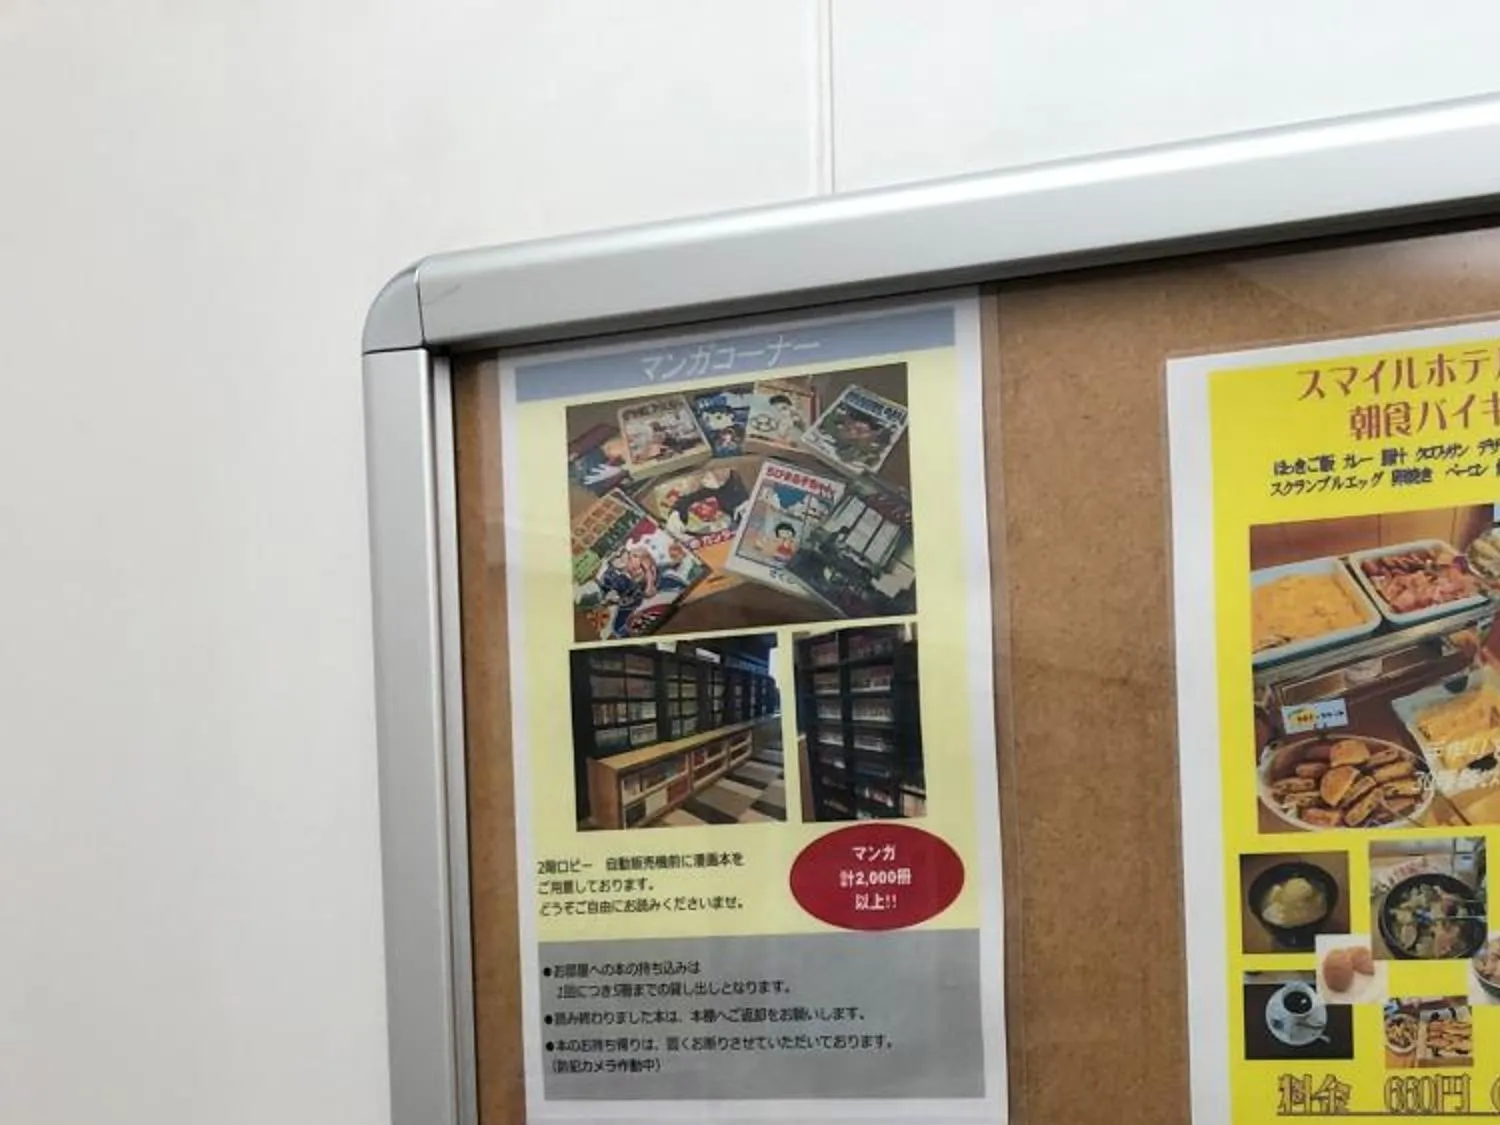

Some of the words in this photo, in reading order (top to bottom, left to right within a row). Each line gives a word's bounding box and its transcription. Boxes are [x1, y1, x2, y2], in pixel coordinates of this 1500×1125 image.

[640, 334, 820, 382] マンガコーナー
[1270, 471, 1385, 497] スクランブルエッグ
[852, 845, 896, 862] マンガ
[840, 868, 912, 888] 計2,000冊
[1278, 1073, 1353, 1114] 料金
